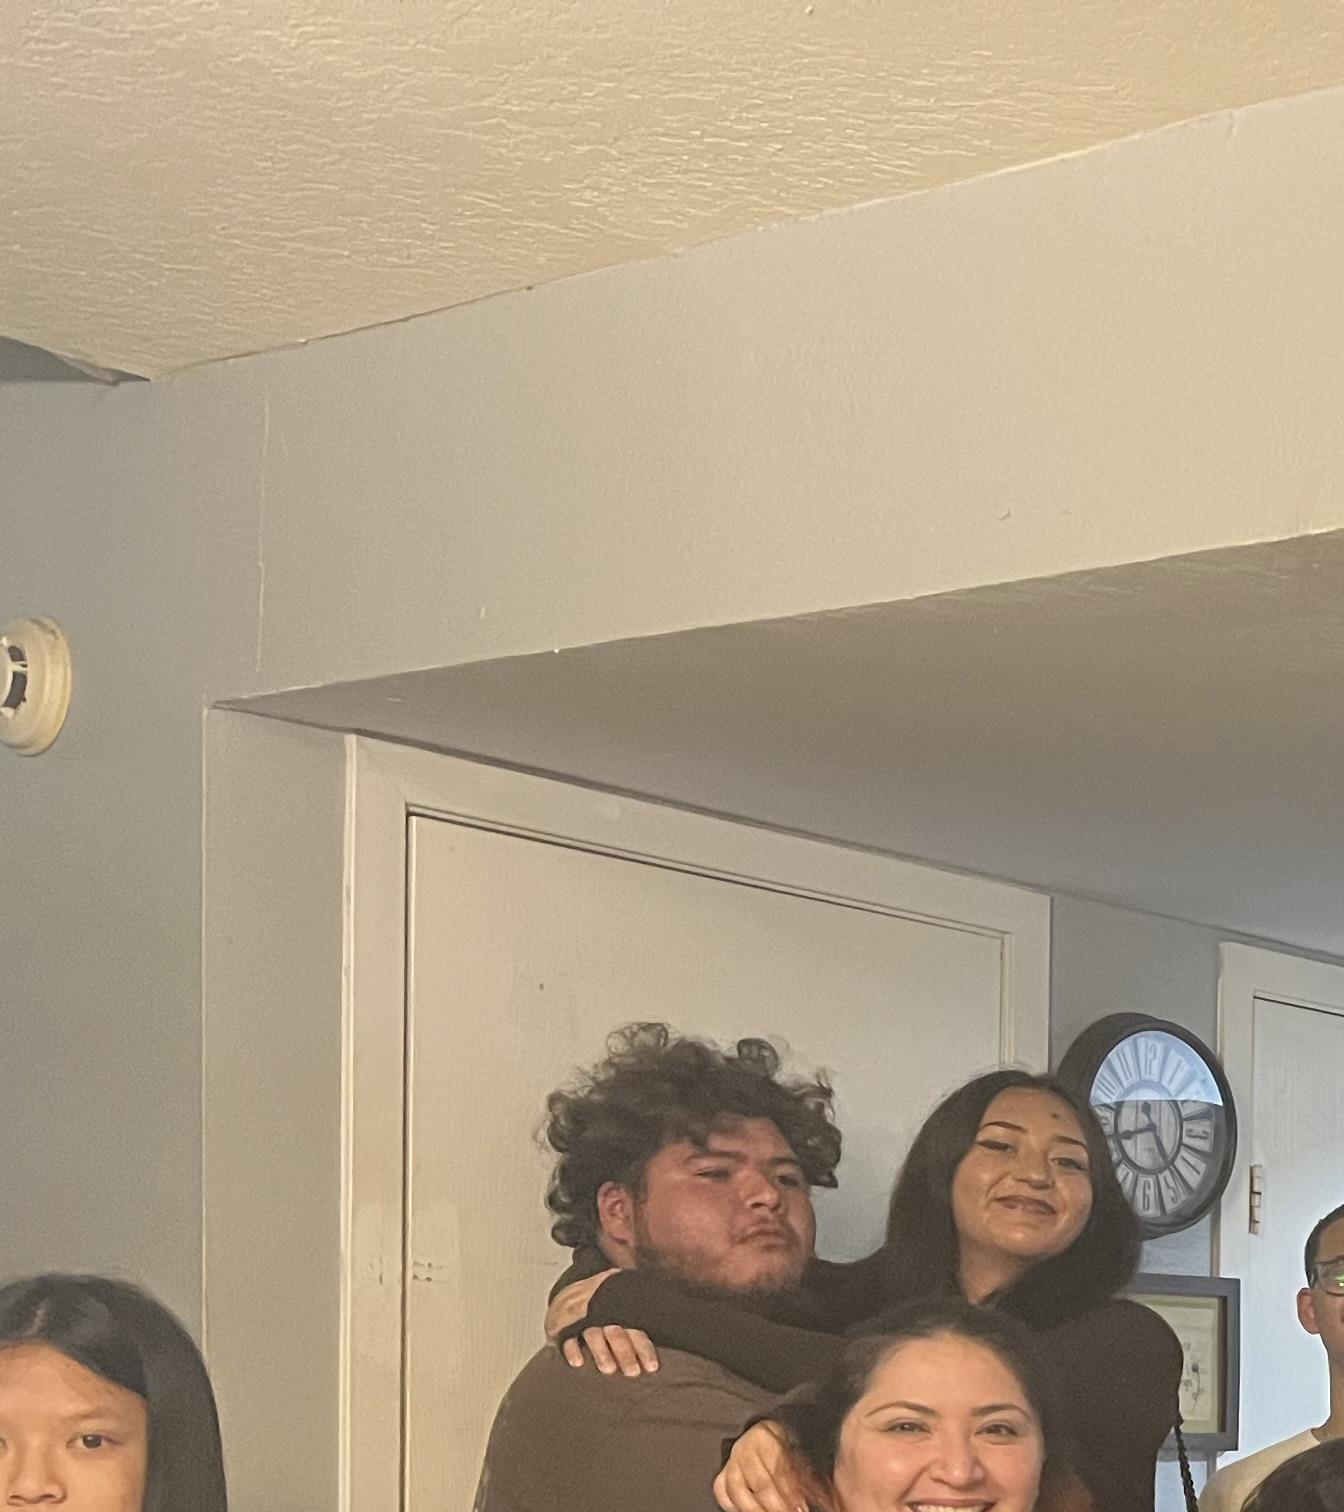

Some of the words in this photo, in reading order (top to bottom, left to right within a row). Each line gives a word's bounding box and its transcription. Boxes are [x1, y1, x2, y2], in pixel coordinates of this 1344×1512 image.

[1145, 1041, 1158, 1078] 12
[1142, 1179, 1151, 1212] 6
[1163, 1174, 1179, 1204] 5
